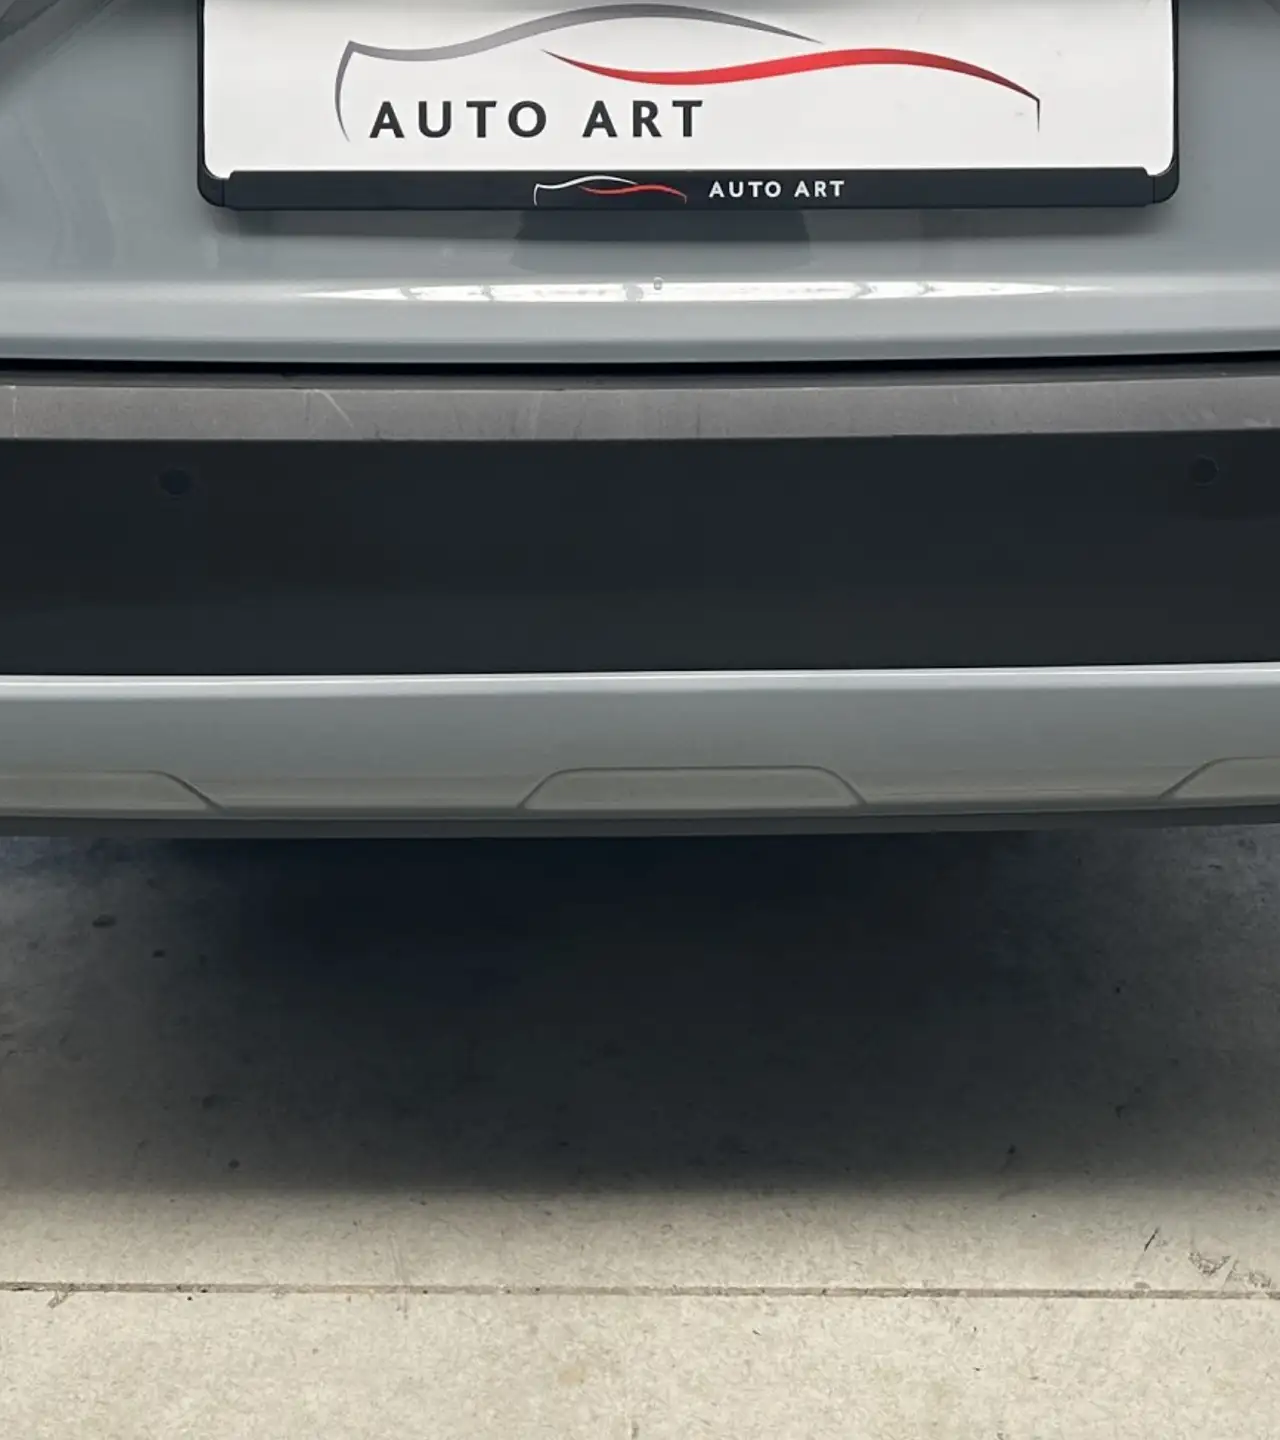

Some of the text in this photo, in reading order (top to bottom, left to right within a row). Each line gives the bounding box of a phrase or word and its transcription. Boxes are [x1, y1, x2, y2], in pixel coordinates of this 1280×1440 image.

[370, 101, 703, 138] AUTO ART
[708, 180, 845, 198] AUTO ART
